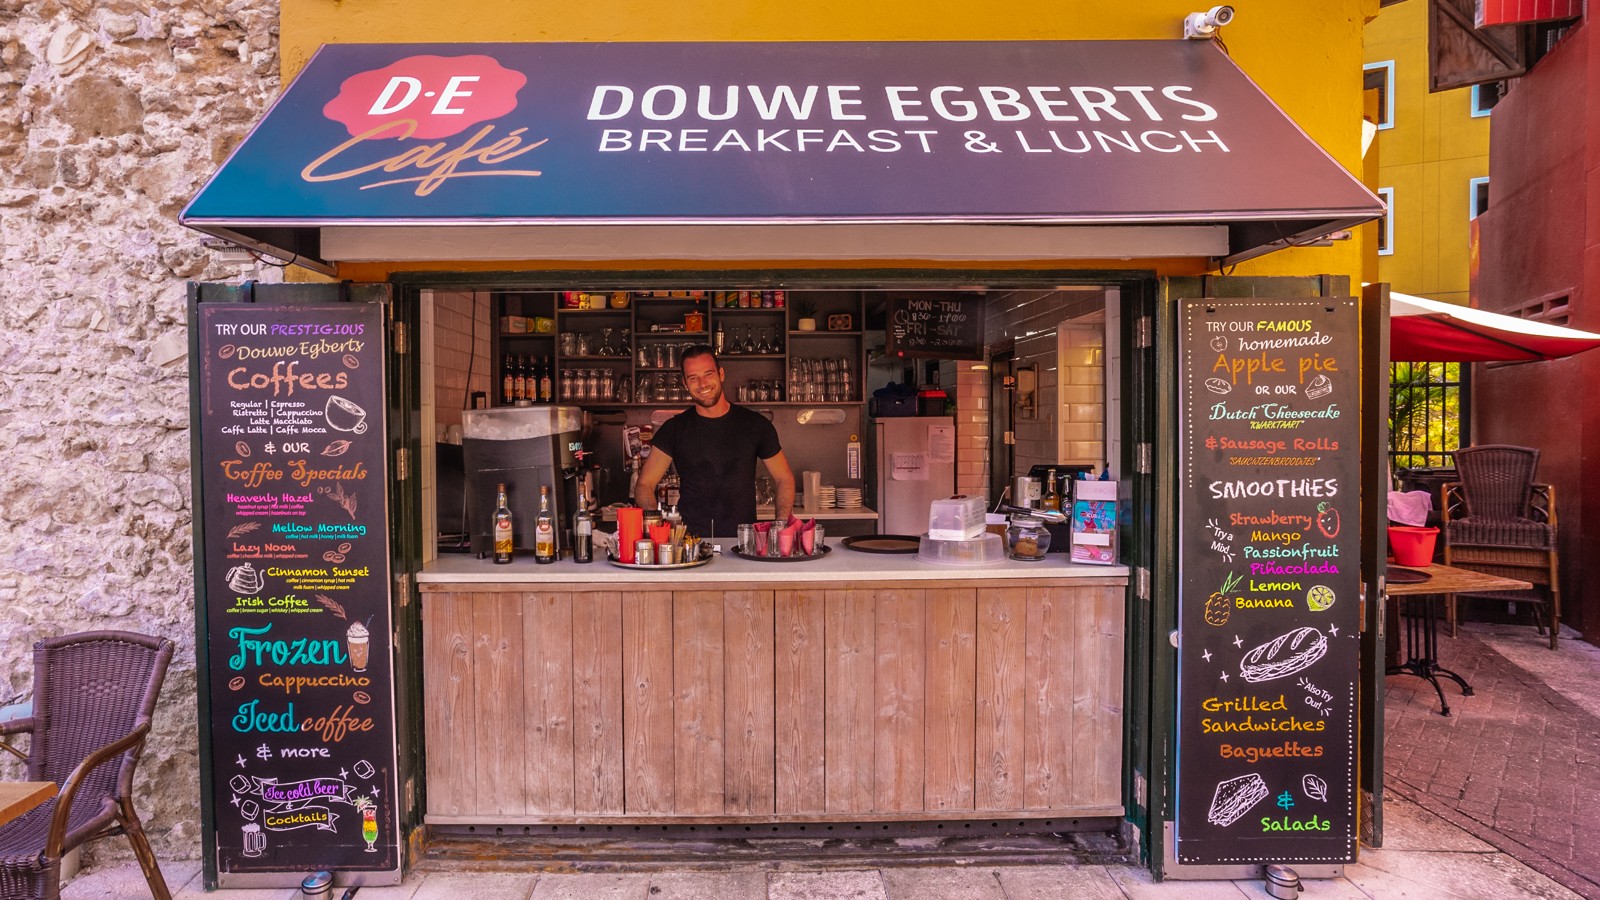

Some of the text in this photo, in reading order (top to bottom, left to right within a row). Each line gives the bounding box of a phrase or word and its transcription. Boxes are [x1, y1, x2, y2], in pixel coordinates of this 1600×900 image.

[587, 85, 1219, 122] DOUWE EGBERTS
[598, 129, 1231, 153] BREAKFAST & LUNCH
[301, 119, 548, 197] Café
[215, 324, 364, 336] TRY OUR PRESTIGIOUS
[1206, 320, 1312, 332] TRY OUR FAMOUS
[236, 338, 364, 360] Douwe Egberts
[1238, 332, 1333, 352] homemade
[1212, 352, 1338, 385] Apple pie
[228, 360, 348, 396] Coffees
[1255, 385, 1296, 395] OR OUR
[230, 401, 305, 410] Regular Espresso
[1209, 401, 1340, 420] Dutch Cheesecake
[276, 410, 323, 419] Cappuccino
[222, 426, 245, 435] Caffe
[276, 426, 299, 435] Caffe
[264, 441, 310, 455] & OUR
[1294, 438, 1339, 451] Rolls
[220, 460, 368, 488] Coffee Specials
[227, 493, 314, 506] Heavenly Hazel
[1230, 510, 1312, 530] Strawberry
[272, 523, 366, 535] Mellow Morning
[1214, 526, 1234, 541] Try a
[1251, 530, 1301, 545] Mango
[234, 542, 296, 556] Lazy Noon
[1244, 542, 1339, 560] Passionfruit
[267, 566, 369, 576] Cinnamon Sunset
[1250, 560, 1340, 576] Piñacolada
[1250, 580, 1302, 592] Lemon
[236, 595, 308, 608] Irish Coffee
[1236, 598, 1294, 609] Banana
[228, 622, 348, 671] Frozen
[259, 673, 370, 694] Cappuccino
[1304, 683, 1334, 702] Also Try
[1202, 694, 1288, 712] Grilled
[1304, 696, 1322, 710] Our!
[232, 698, 374, 742] Iced coffee
[1202, 716, 1325, 733] Sandwiches
[256, 743, 330, 760] & more
[1220, 742, 1323, 763] Baguettes
[264, 780, 339, 800] Ice cold beer
[286, 802, 294, 810] &
[1277, 790, 1294, 810] &
[266, 812, 328, 826] Cocktails
[1260, 815, 1331, 832] Salads
